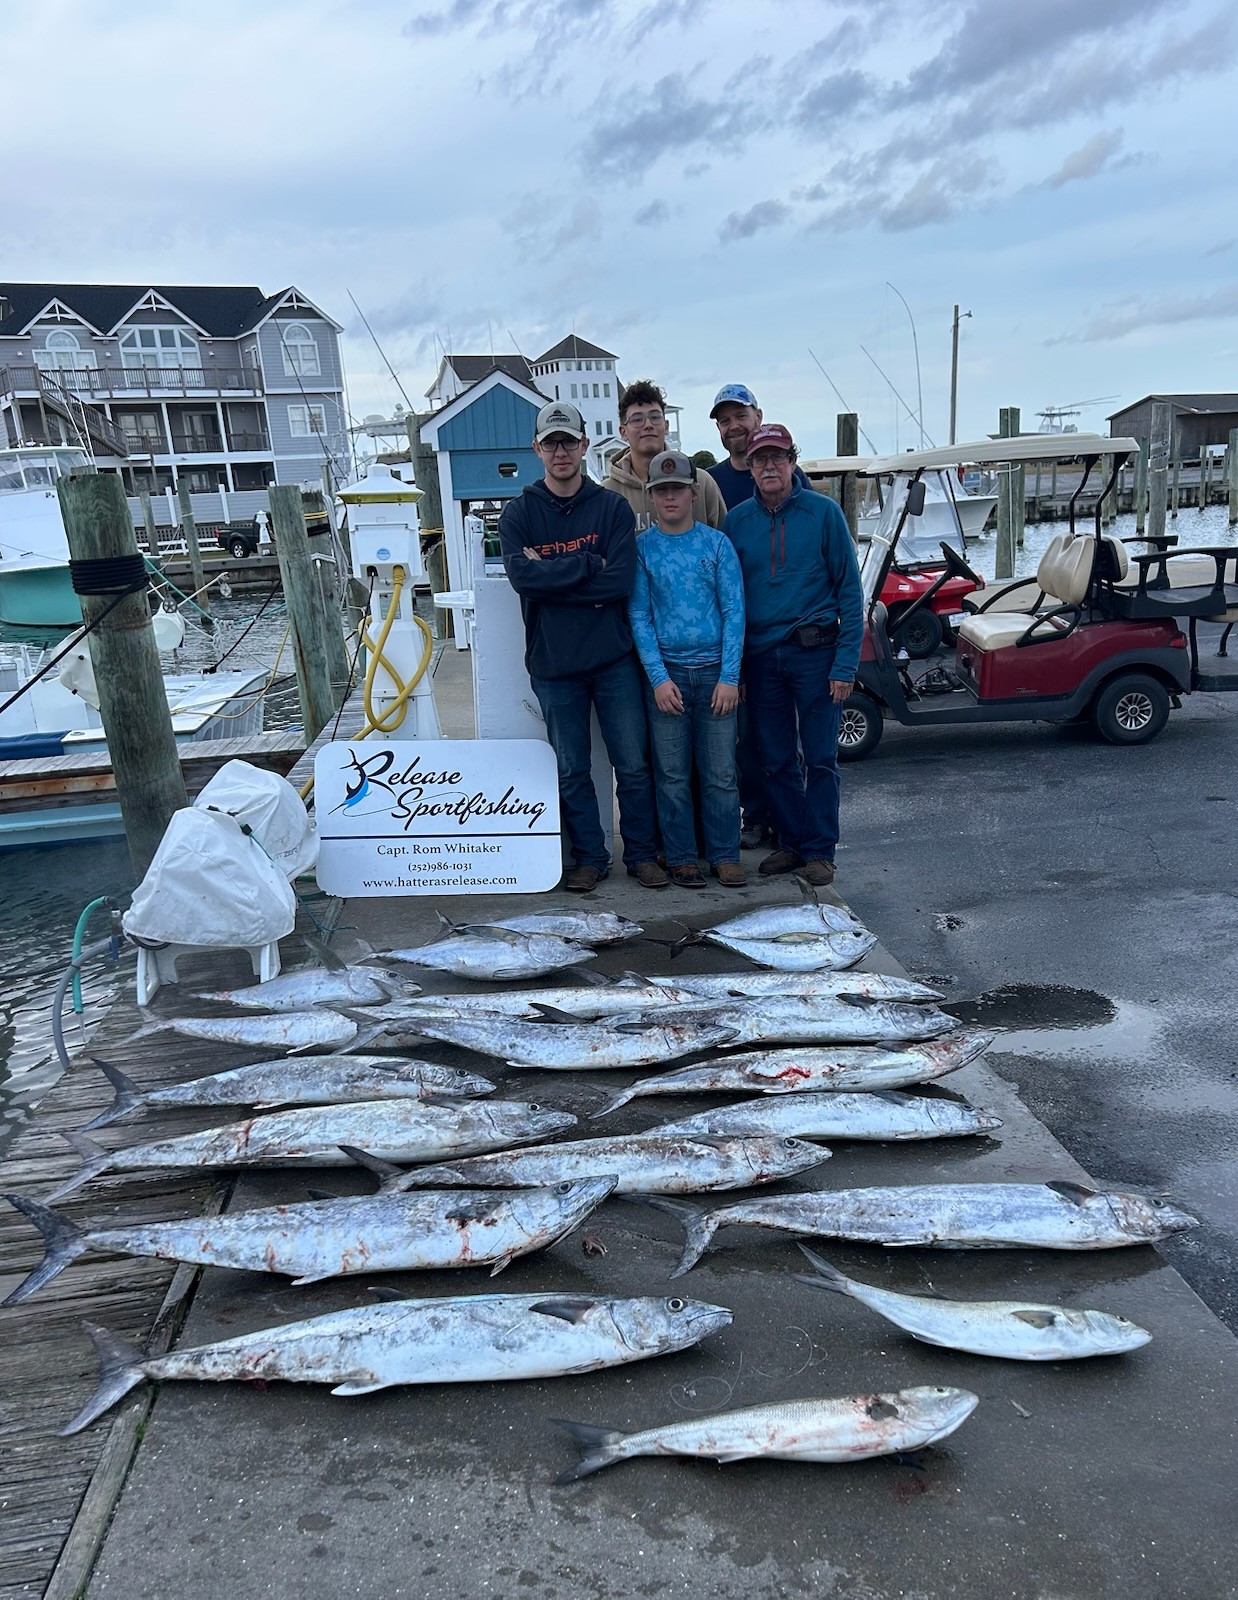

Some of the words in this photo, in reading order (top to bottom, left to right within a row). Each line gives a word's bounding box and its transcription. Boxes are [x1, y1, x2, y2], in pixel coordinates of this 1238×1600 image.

[359, 750, 463, 797] Release
[391, 785, 547, 831] Sportfishing
[377, 844, 409, 857] Capt.
[413, 844, 441, 854] Rom
[444, 842, 502, 854] Whitaker
[408, 861, 472, 872] (252)986-1031
[362, 874, 517, 888] www.hatterasrelease.com
